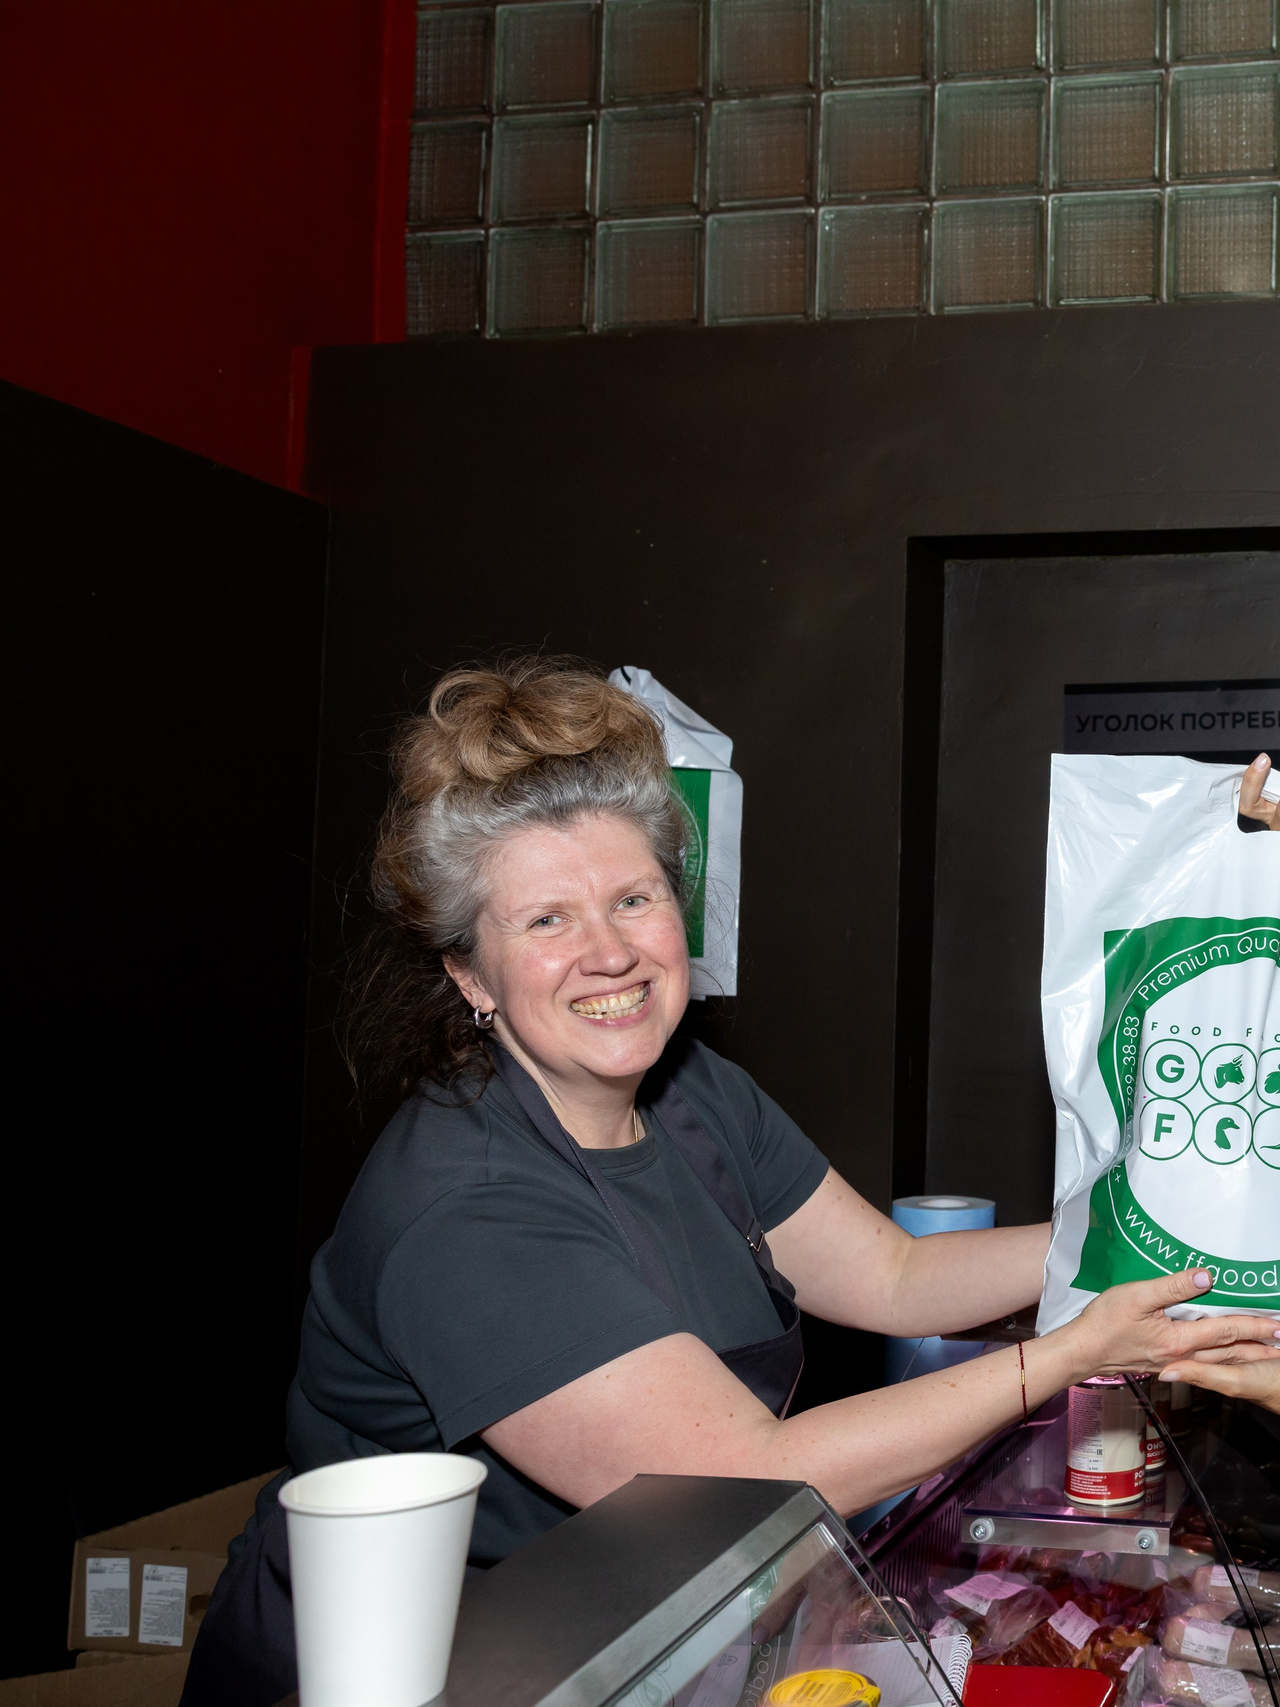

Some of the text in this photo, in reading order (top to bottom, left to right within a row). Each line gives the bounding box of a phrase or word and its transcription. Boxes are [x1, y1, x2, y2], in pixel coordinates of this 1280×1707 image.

[1076, 713, 1174, 733] УГОЛОК
[1137, 943, 1230, 1001] Premium
[1151, 1021, 1222, 1037] FOOD
